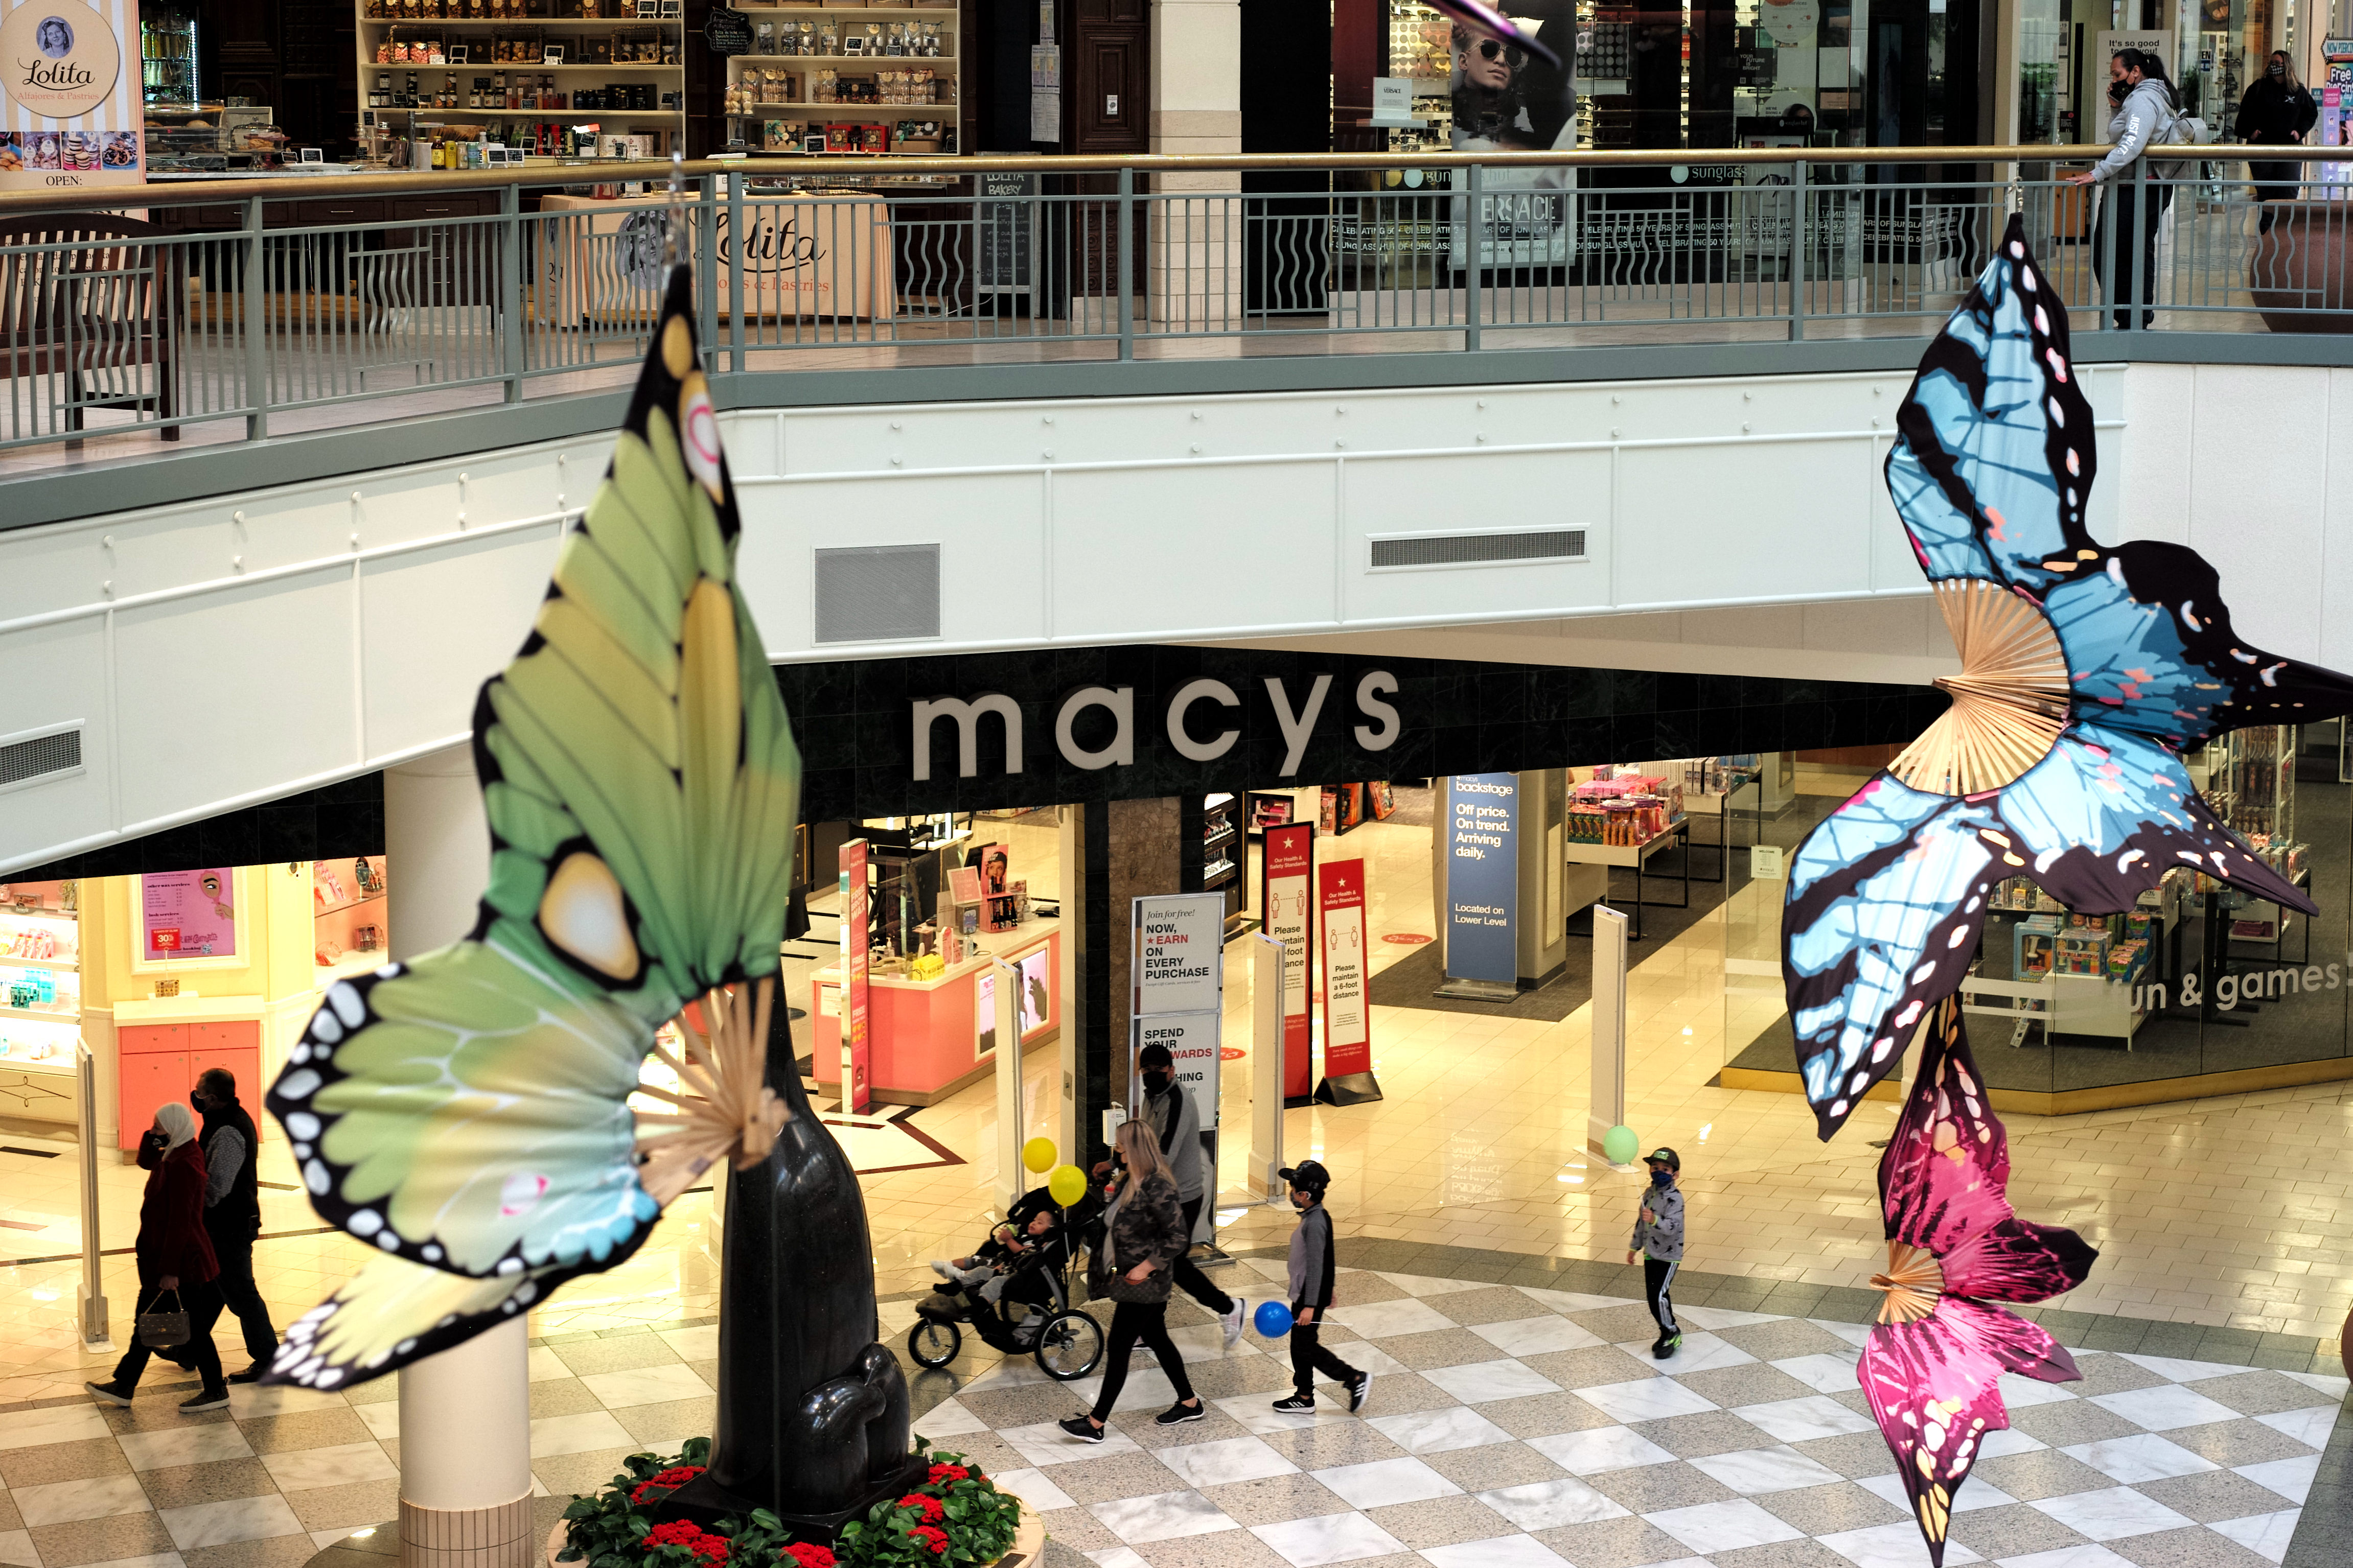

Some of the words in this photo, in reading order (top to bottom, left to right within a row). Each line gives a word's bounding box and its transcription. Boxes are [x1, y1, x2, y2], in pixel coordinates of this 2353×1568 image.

[2137, 39, 2159, 48] good
[18, 58, 96, 91] Lolita
[2331, 68, 2352, 82] Free
[17, 92, 55, 102] Alfajores
[67, 92, 100, 100] Pastries
[2129, 113, 2140, 135] JUST
[1692, 166, 1747, 182] sunglass
[46, 176, 83, 186] OPEN:
[988, 184, 1022, 196] BAKERY
[1481, 196, 1556, 222] ERSACE
[1719, 238, 1742, 246] YARS
[906, 670, 1401, 782] macys
[1456, 780, 1513, 797] backstage
[1456, 803, 1475, 815] Off
[1477, 806, 1509, 818] price.
[1456, 817, 1473, 829] On
[1476, 819, 1510, 832] trend.
[1456, 832, 1502, 848] Arriving
[1456, 846, 1486, 860] daily.
[851, 882, 865, 903] FREE
[851, 901, 865, 922] WAX
[1455, 903, 1491, 914] Located
[1146, 910, 1163, 921] Join
[1163, 910, 1176, 921] for
[1175, 909, 1195, 920] free!
[1455, 914, 1483, 924] Lower
[1484, 917, 1507, 926] Level
[1146, 923, 1177, 934] NOW,
[1274, 925, 1301, 935] Please
[1156, 934, 1188, 945] EARN
[1279, 936, 1305, 946] intain
[1146, 947, 1163, 956] ON
[1285, 947, 1303, 956] -foot
[852, 953, 865, 967] FREE
[1146, 957, 1184, 968] EVERY
[1285, 959, 1304, 968] ance
[1145, 967, 1209, 979] PURCHASE
[1335, 964, 1355, 972] Please
[1332, 972, 1358, 982] maintain
[1339, 981, 1358, 990] 6-foot
[2180, 972, 2203, 1008] &
[2216, 963, 2340, 1011] games
[1333, 990, 1359, 1000] distance
[852, 1005, 865, 1019] FREE
[1144, 1027, 1184, 1039] SPEND
[1170, 1048, 1212, 1060] WARDS
